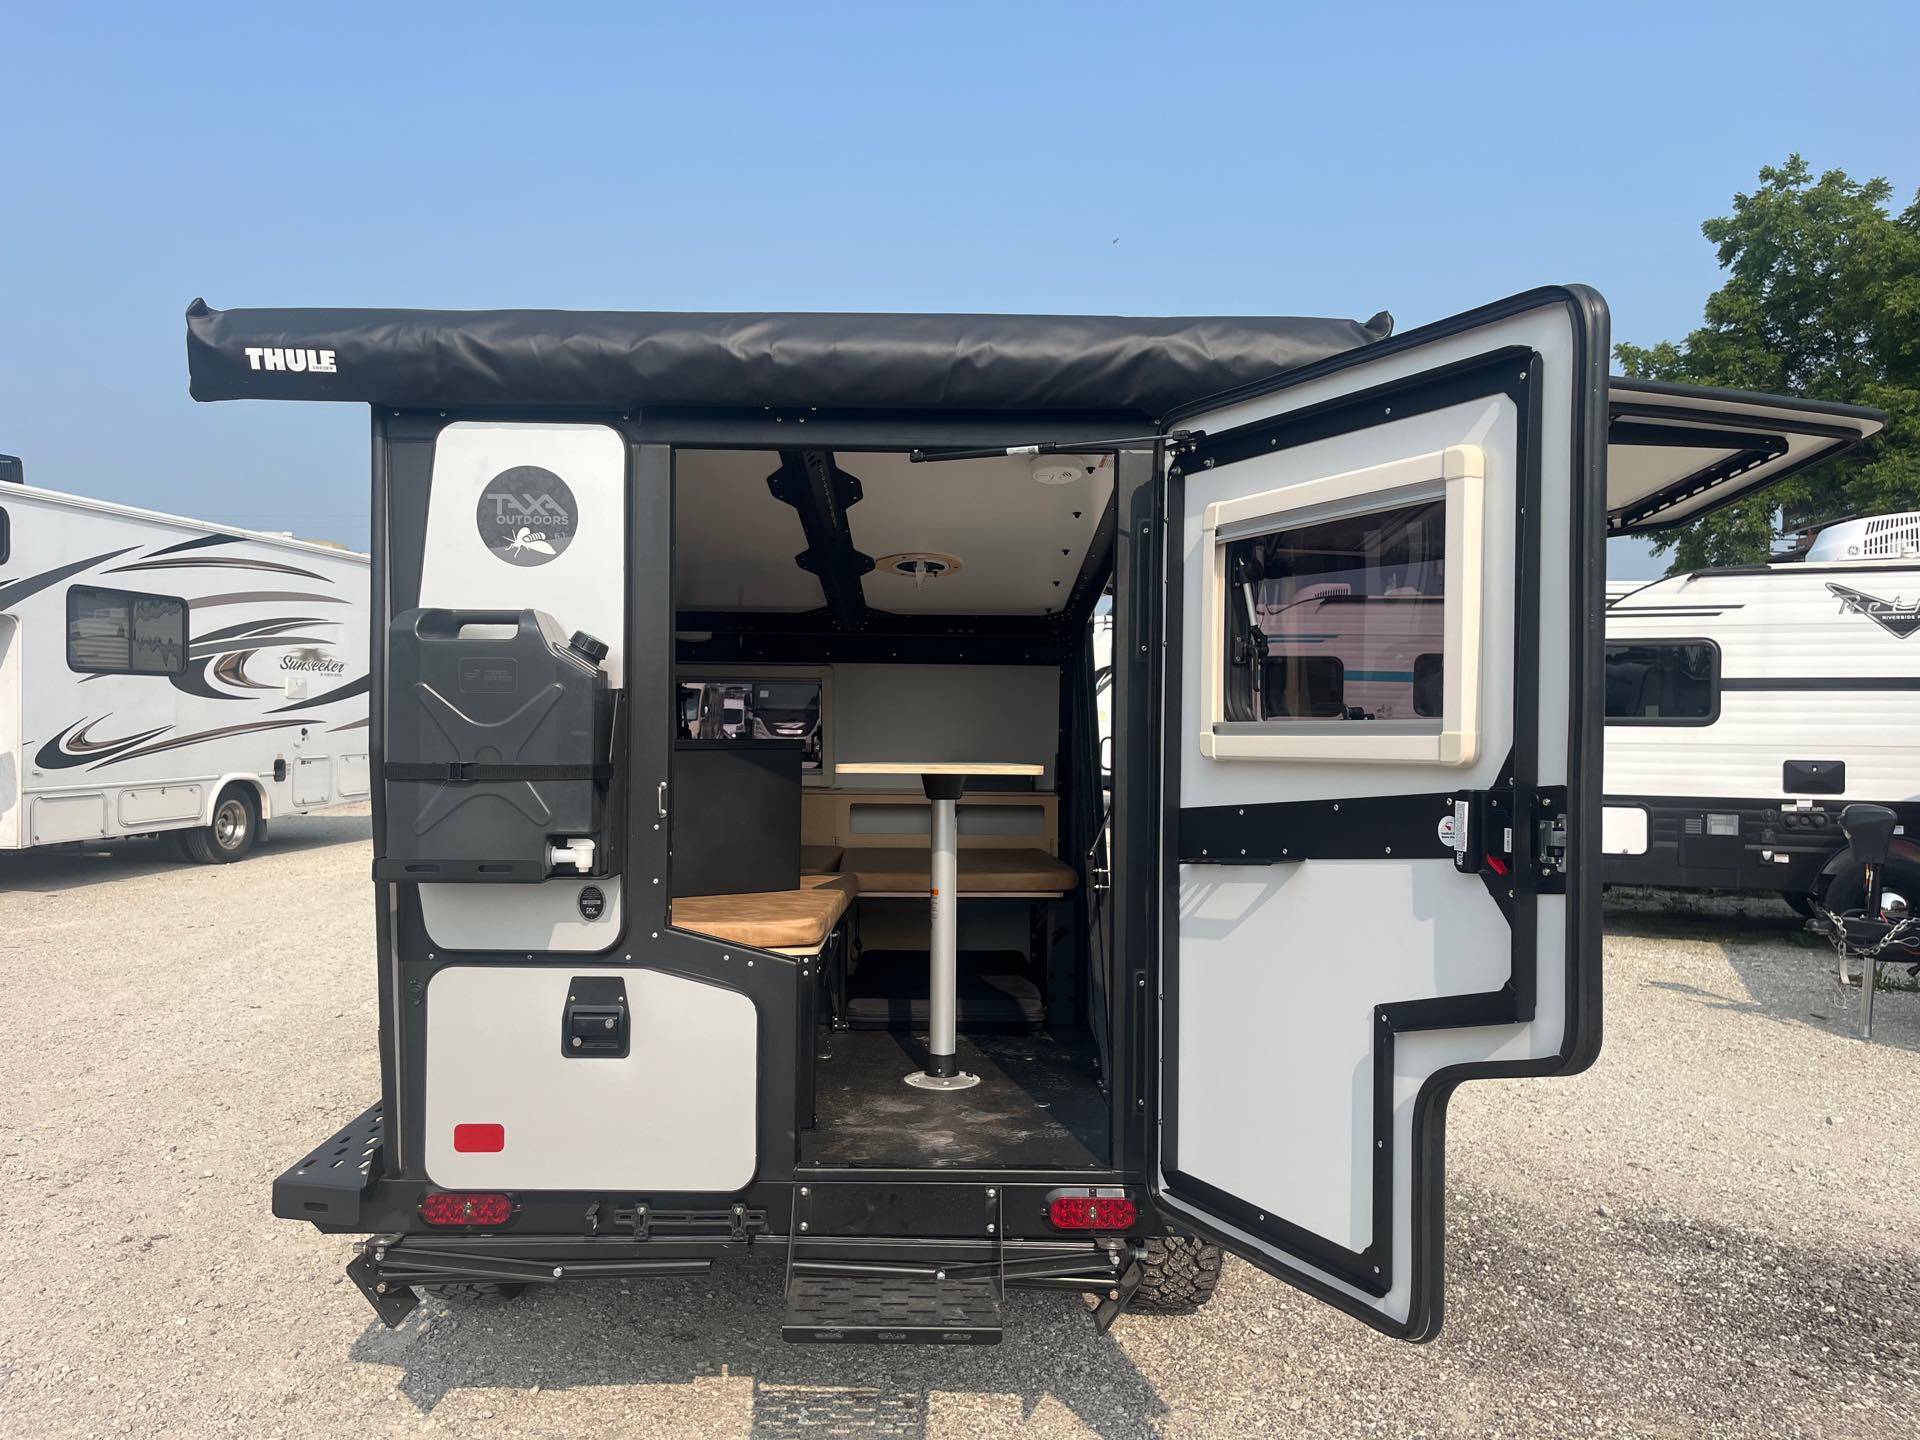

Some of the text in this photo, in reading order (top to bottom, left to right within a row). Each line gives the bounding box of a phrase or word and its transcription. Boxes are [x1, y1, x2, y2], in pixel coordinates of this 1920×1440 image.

[245, 347, 337, 373] THULE
[487, 493, 569, 516] TAXA
[496, 515, 569, 525] OUTDOORS
[280, 655, 345, 673] Sunseeker
